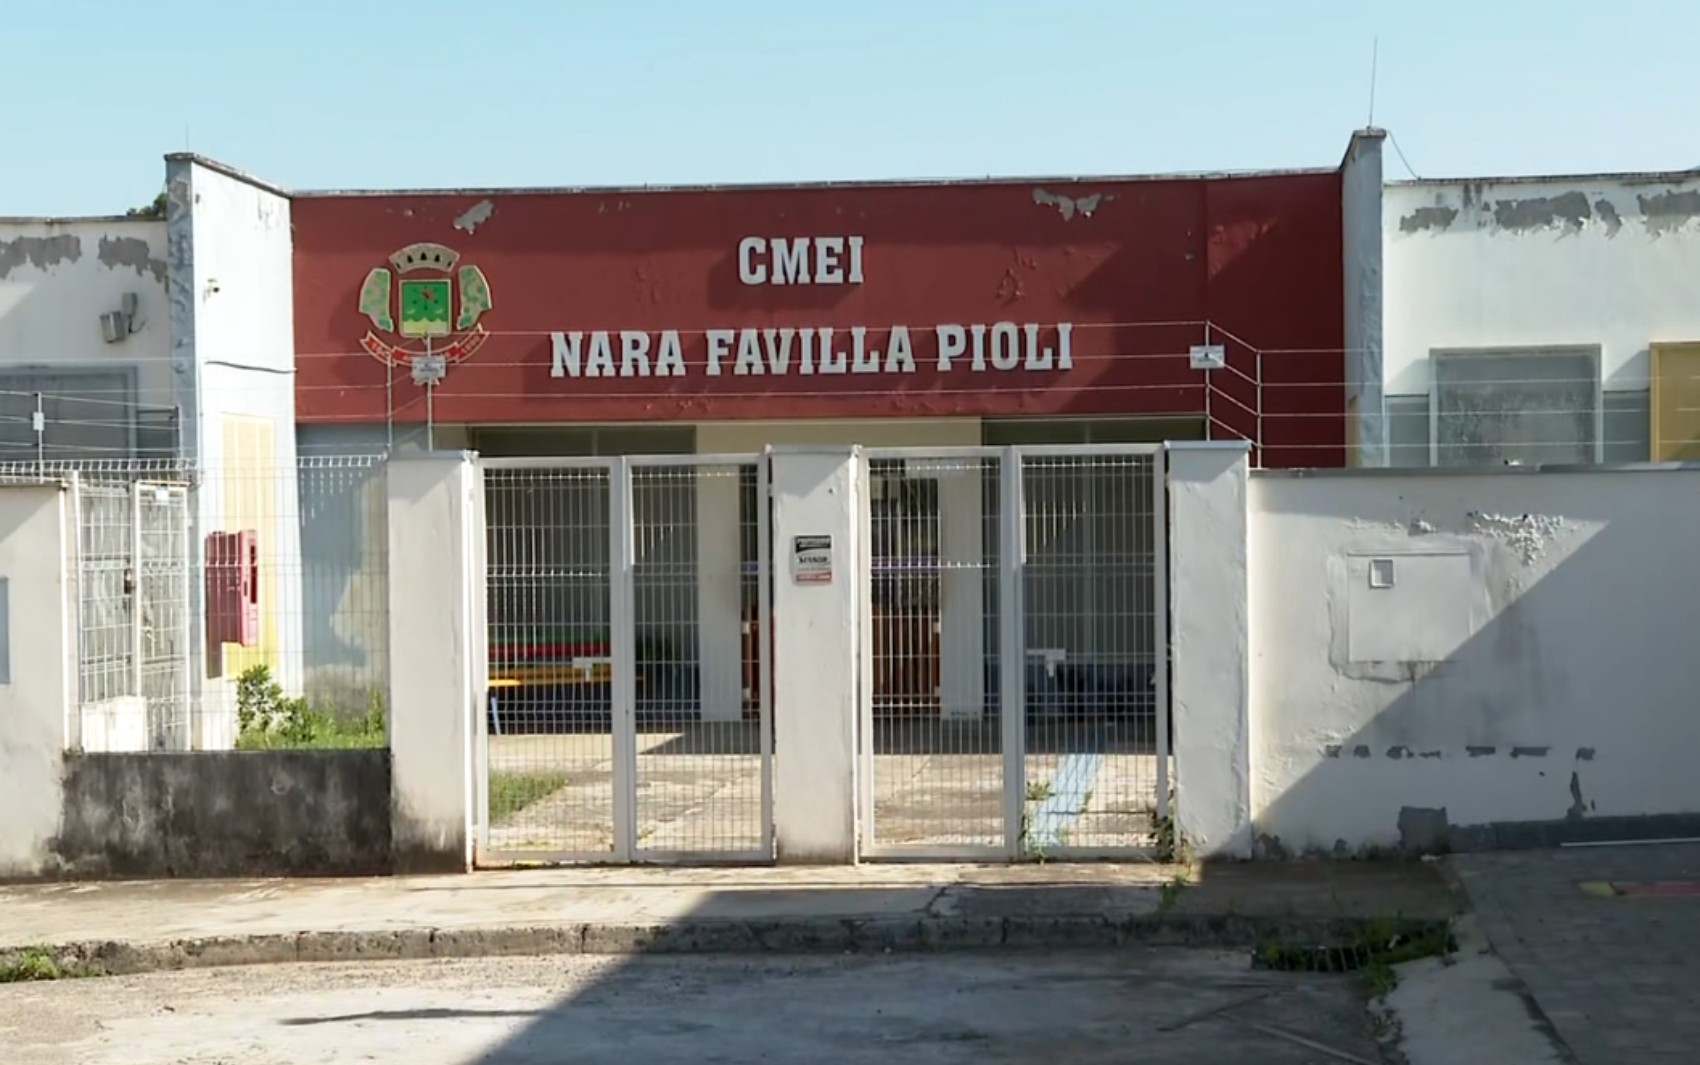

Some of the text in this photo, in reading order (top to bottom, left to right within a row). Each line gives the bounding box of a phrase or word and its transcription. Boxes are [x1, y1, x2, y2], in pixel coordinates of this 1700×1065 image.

[738, 236, 864, 285] CMEI
[550, 321, 1073, 378] NARA FAVILLA PIOLI
